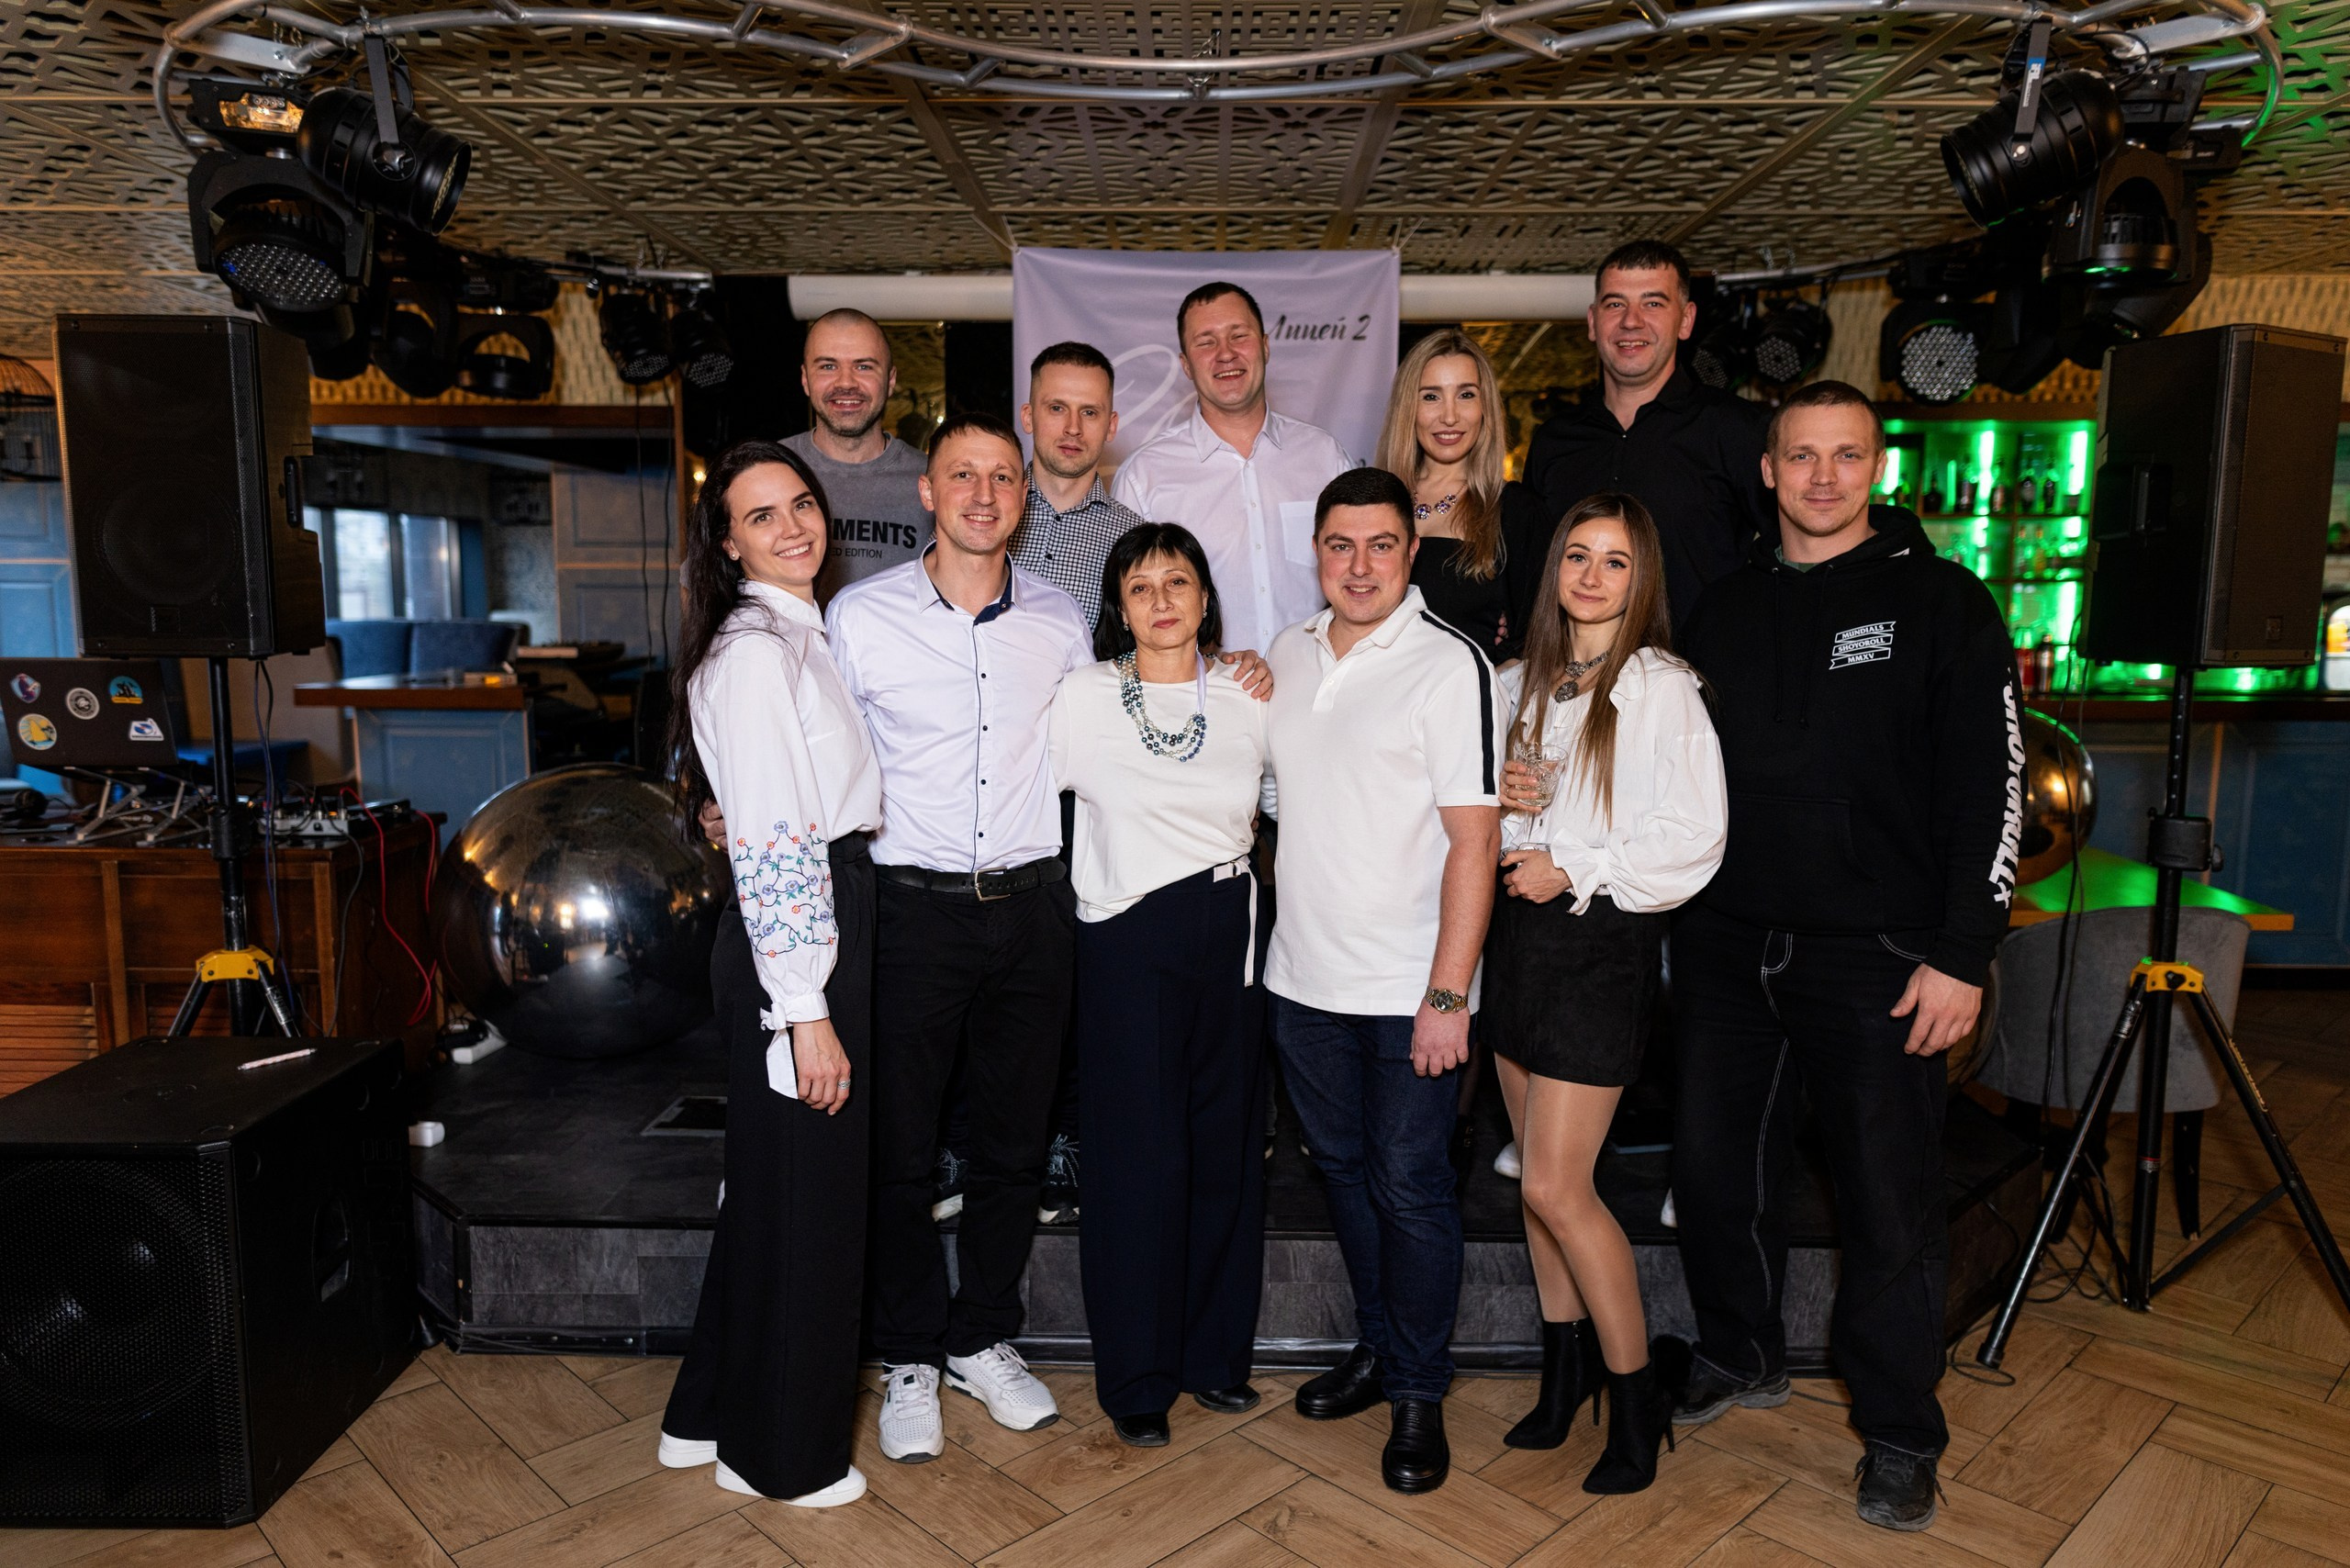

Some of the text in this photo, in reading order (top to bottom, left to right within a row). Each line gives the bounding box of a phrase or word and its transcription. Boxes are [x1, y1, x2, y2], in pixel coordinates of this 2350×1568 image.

[1268, 314, 1371, 342] Лицей 2
[845, 547, 883, 559] EDITION
[1841, 624, 1885, 640] MUNDIALS
[1838, 637, 1886, 653] SHOYOROLL
[1847, 653, 1874, 664] MMXV
